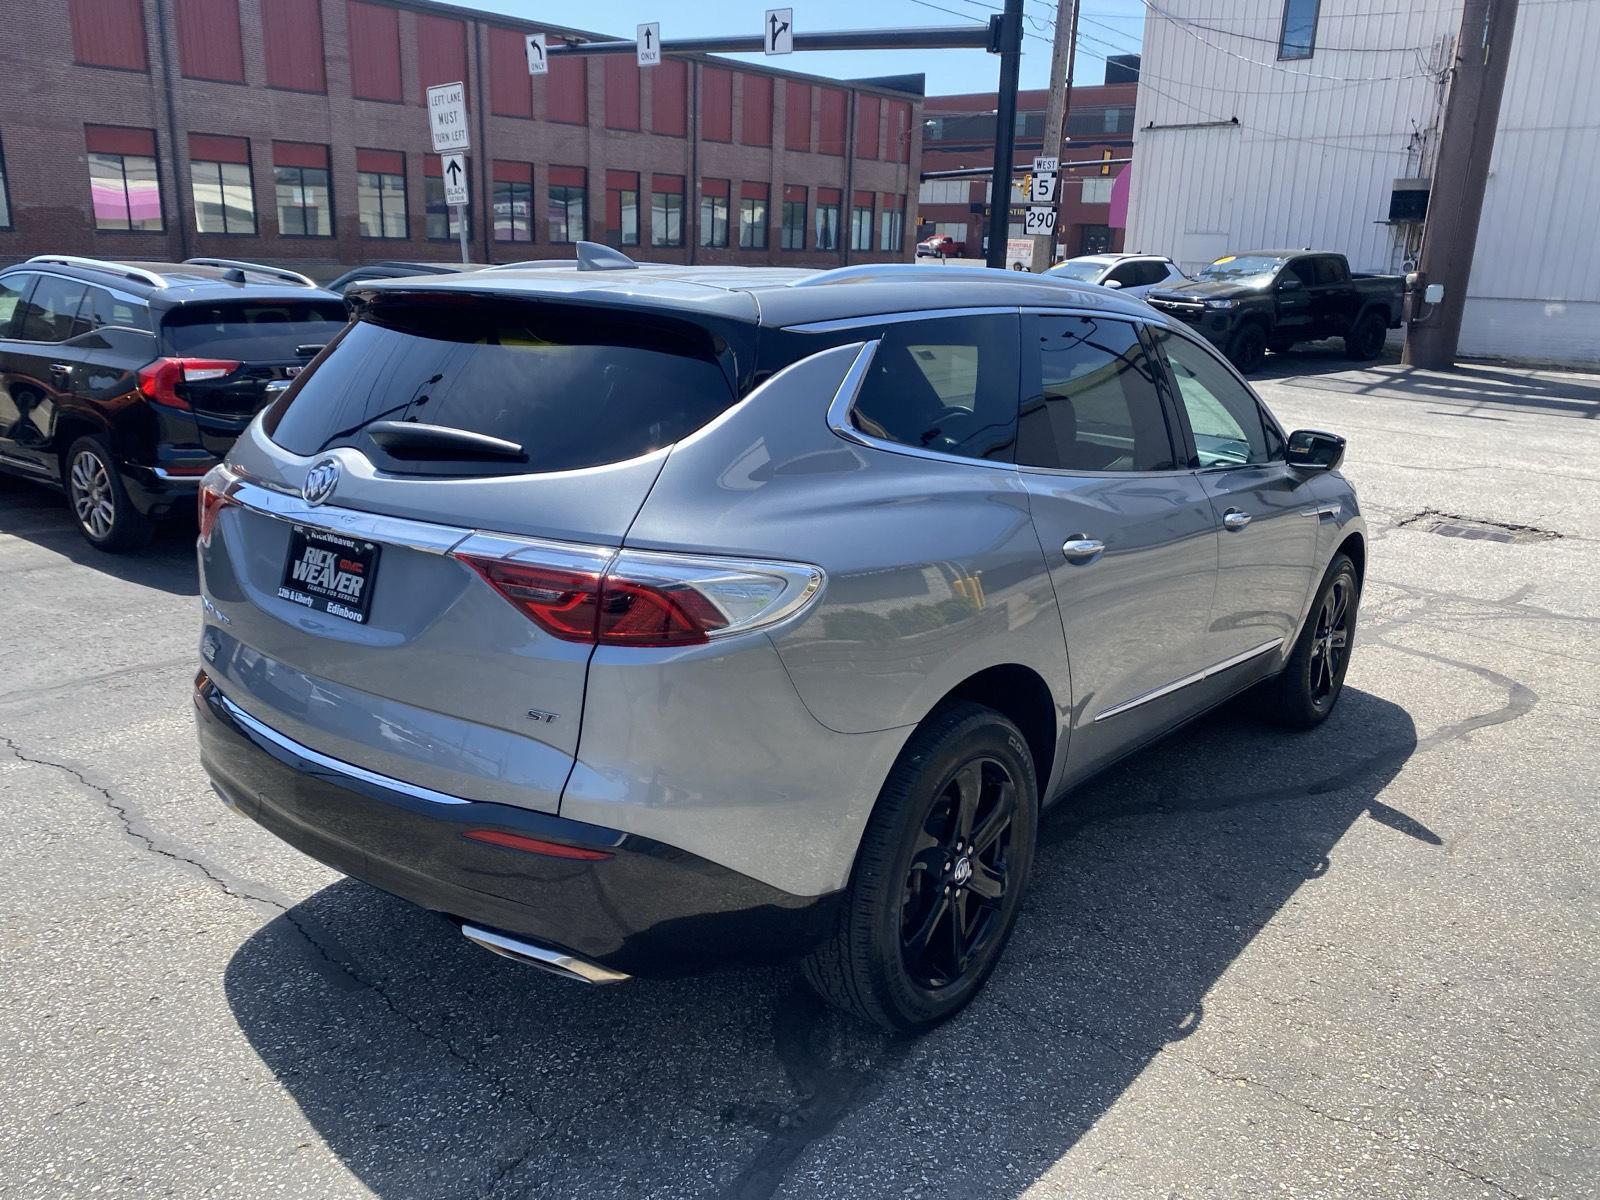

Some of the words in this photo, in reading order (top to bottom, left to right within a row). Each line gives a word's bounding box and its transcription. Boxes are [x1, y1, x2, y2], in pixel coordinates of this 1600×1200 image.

[641, 52, 656, 61] ONLY
[531, 62, 545, 70] ONLY
[431, 95, 445, 107] LEFT
[447, 92, 461, 103] LANE
[438, 111, 458, 125] MUST
[435, 133, 450, 144] TURN
[452, 130, 465, 140] LEFT
[1036, 159, 1055, 170] WEST
[1038, 180, 1048, 195] 5
[1027, 212, 1054, 228] 290
[303, 546, 338, 568] RICK
[292, 559, 364, 597] WEAVER
[295, 592, 314, 607] Liberty
[326, 602, 363, 622] Edinboro
[527, 709, 560, 723] ST
